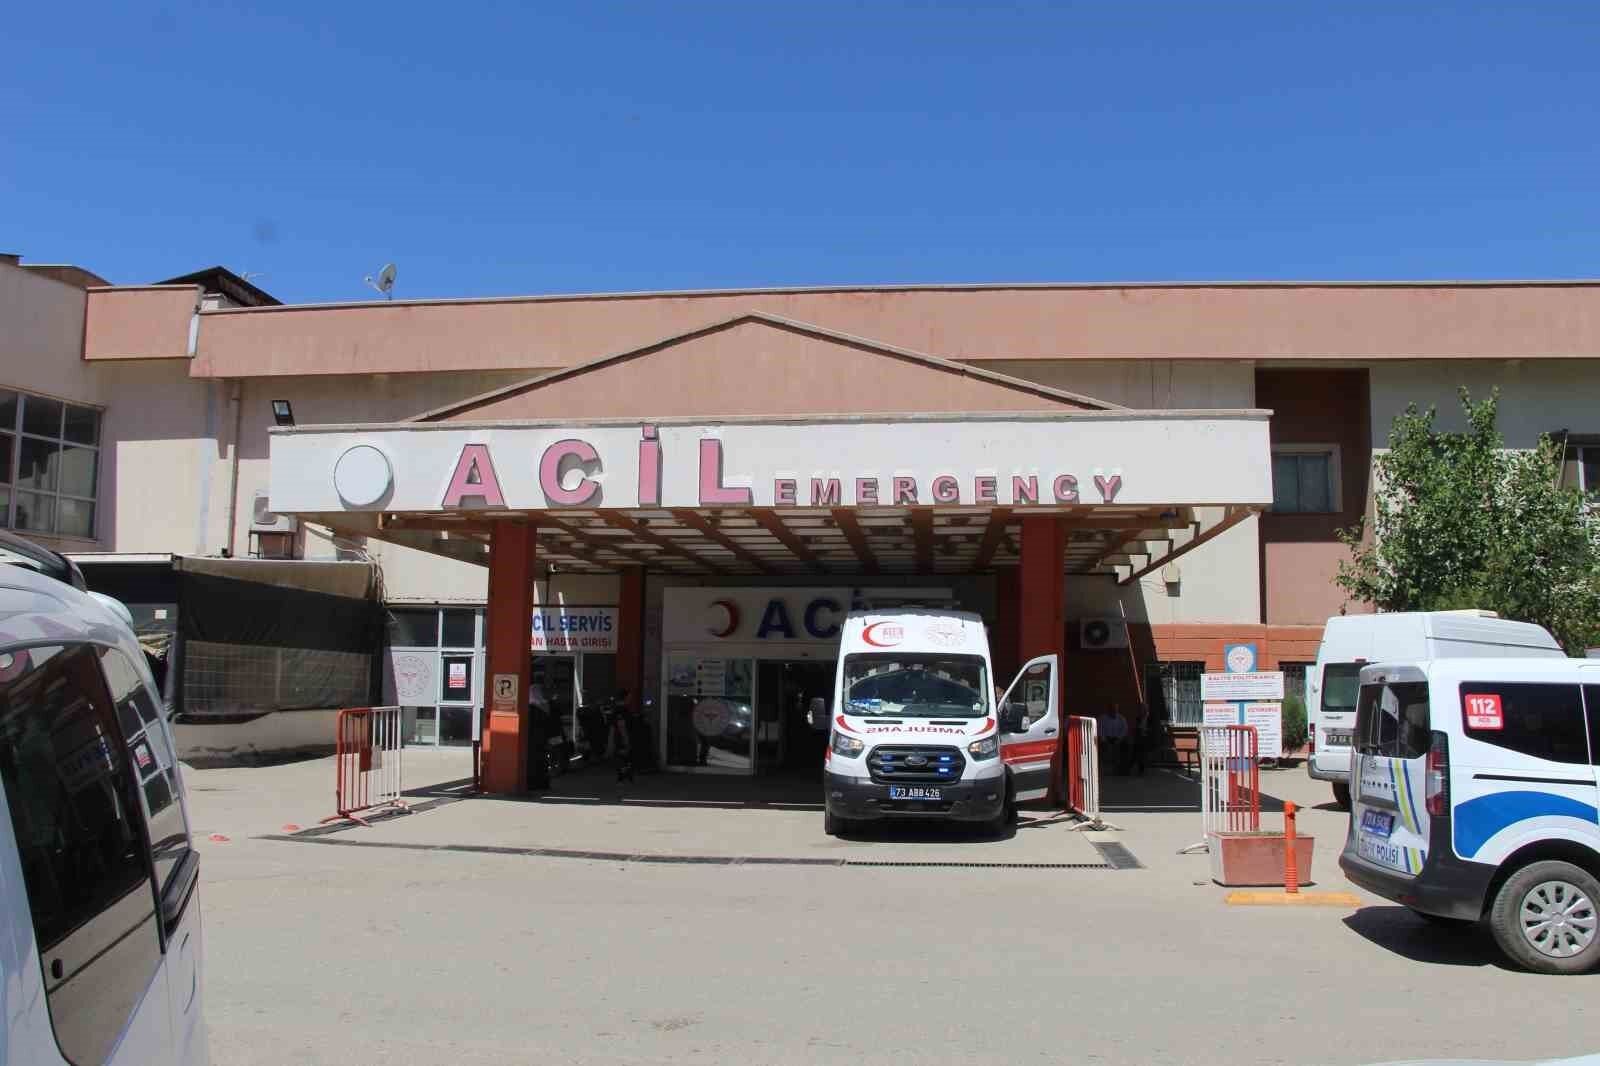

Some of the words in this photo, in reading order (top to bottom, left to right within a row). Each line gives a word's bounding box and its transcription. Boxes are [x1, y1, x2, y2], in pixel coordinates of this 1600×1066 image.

[441, 423, 752, 506] ACİL
[774, 475, 1122, 504] EMERGENCY
[530, 610, 555, 632] CİL
[560, 610, 612, 632] SERVİS
[756, 587, 866, 639] AC
[1470, 698, 1497, 715] 112
[896, 788, 906, 797] 73
